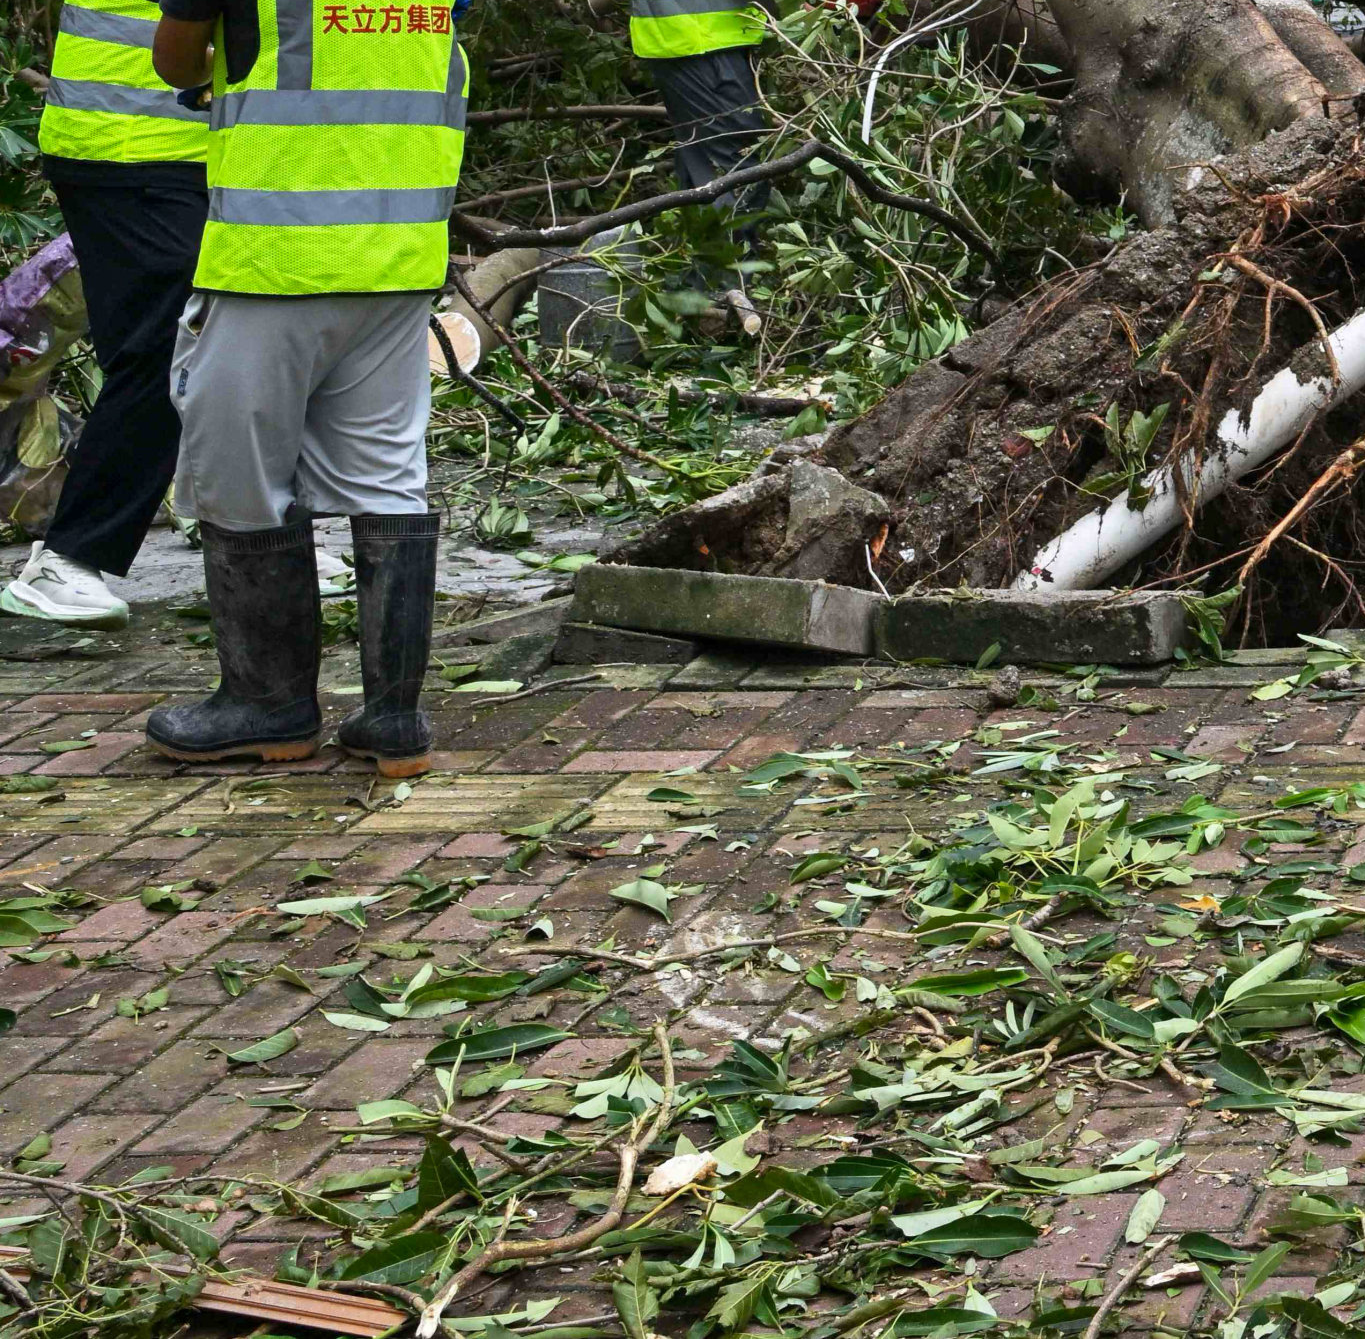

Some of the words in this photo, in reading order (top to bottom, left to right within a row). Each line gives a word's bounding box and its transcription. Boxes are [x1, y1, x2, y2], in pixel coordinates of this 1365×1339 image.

[322, 4, 451, 36] 天立方集团
